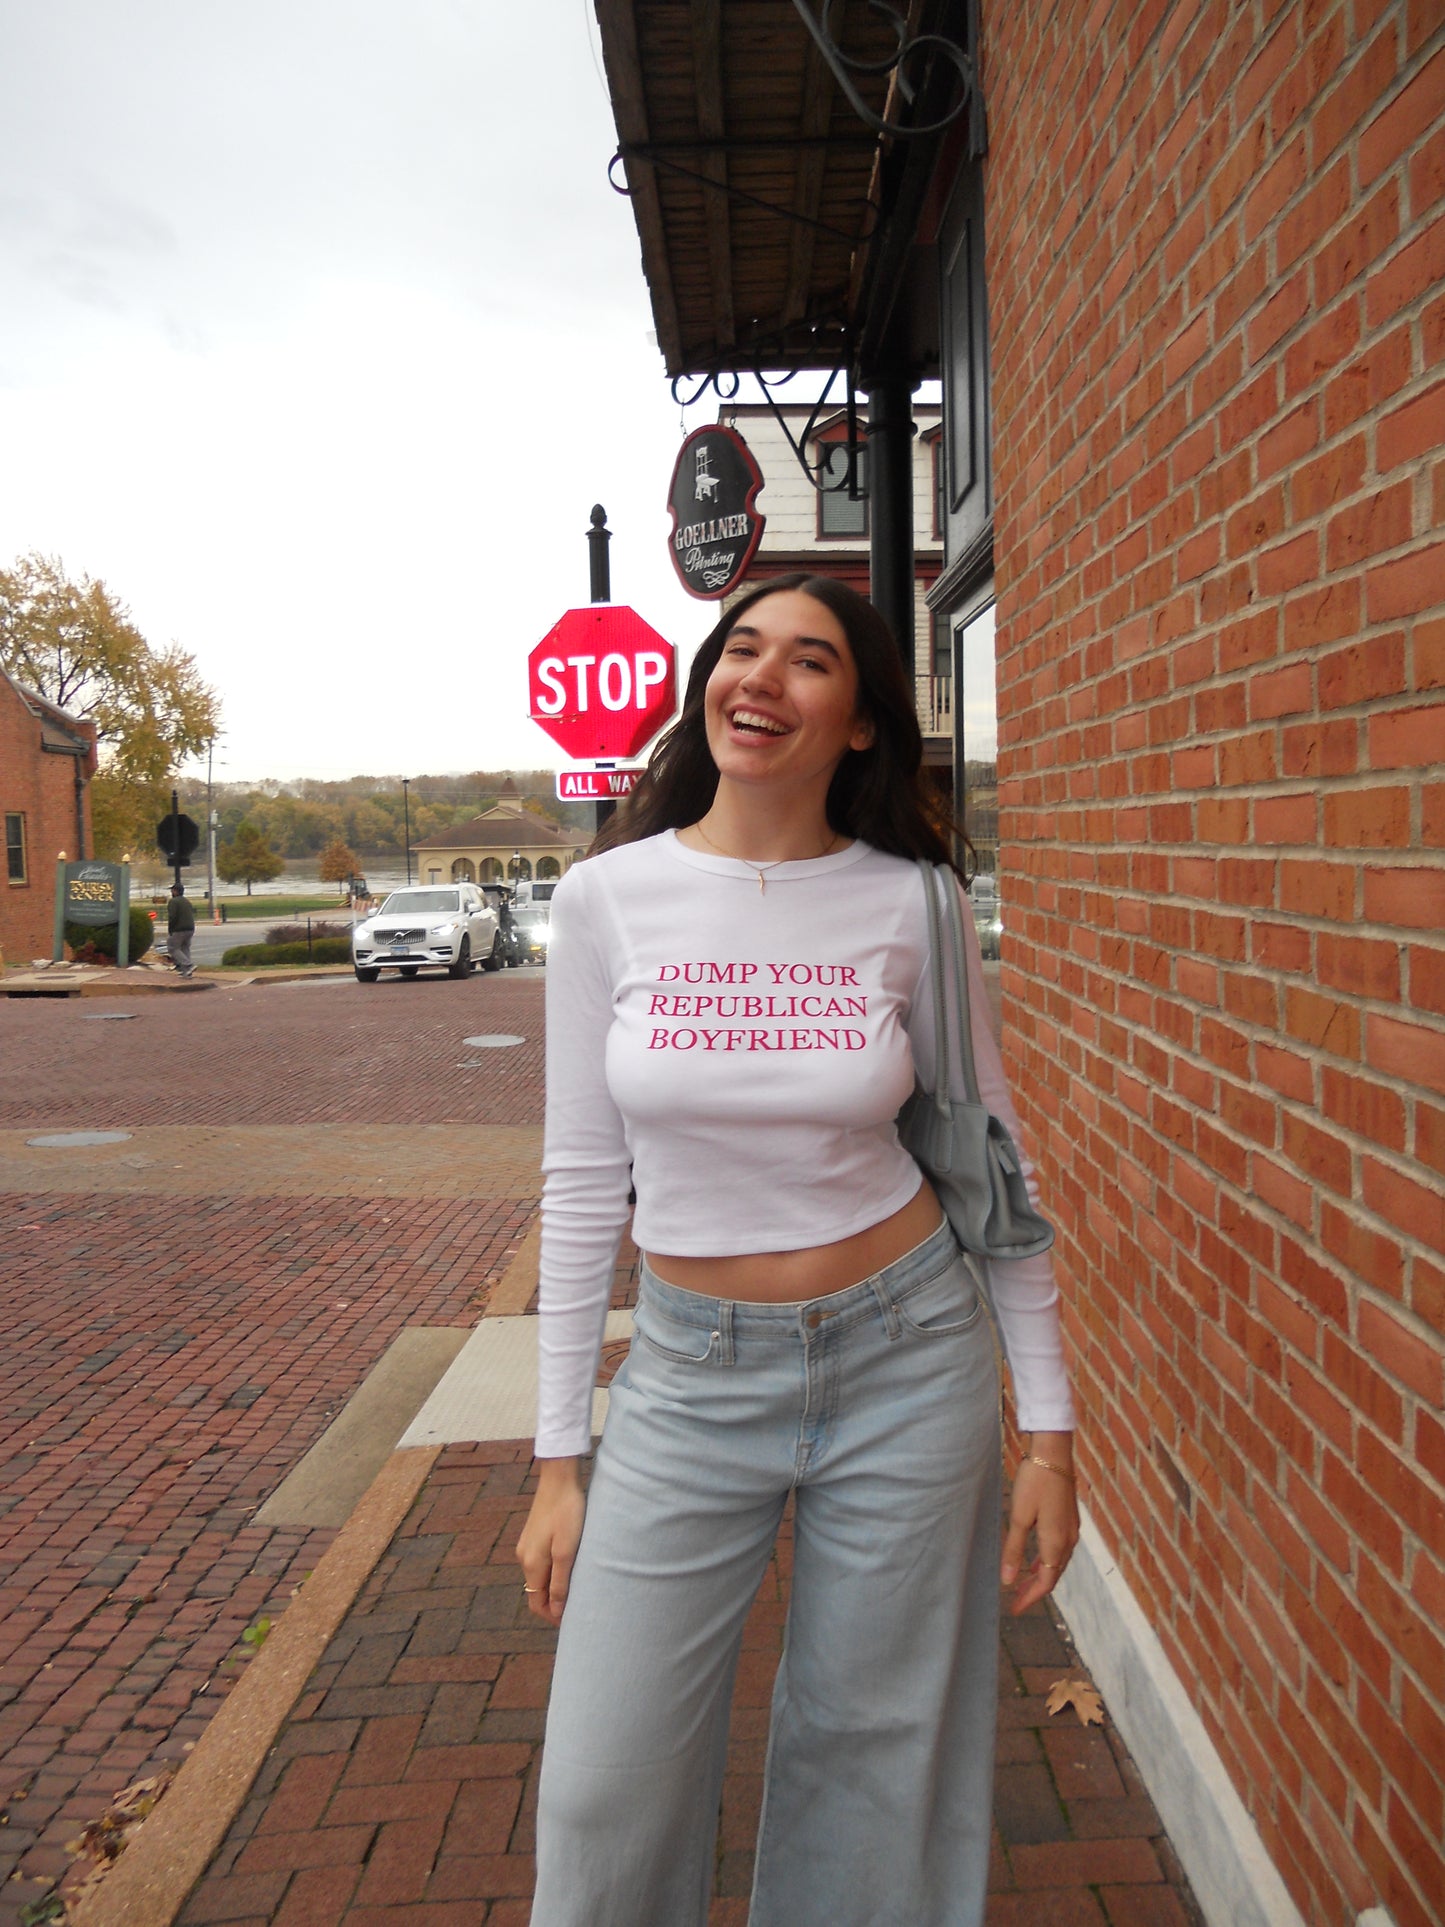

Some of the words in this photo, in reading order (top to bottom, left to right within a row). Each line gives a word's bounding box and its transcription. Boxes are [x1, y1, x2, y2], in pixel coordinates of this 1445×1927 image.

[675, 513, 748, 551] GOELLNER
[685, 547, 735, 573] Printing
[537, 652, 667, 714] STOP
[565, 776, 599, 794] ALL
[70, 880, 115, 892] TOURISM
[70, 890, 115, 902] CENTER
[656, 962, 758, 984] DUMP
[766, 963, 861, 986] YOUR
[648, 994, 868, 1017] REPUBLICAN
[647, 1028, 867, 1051] BOYFRIEND
